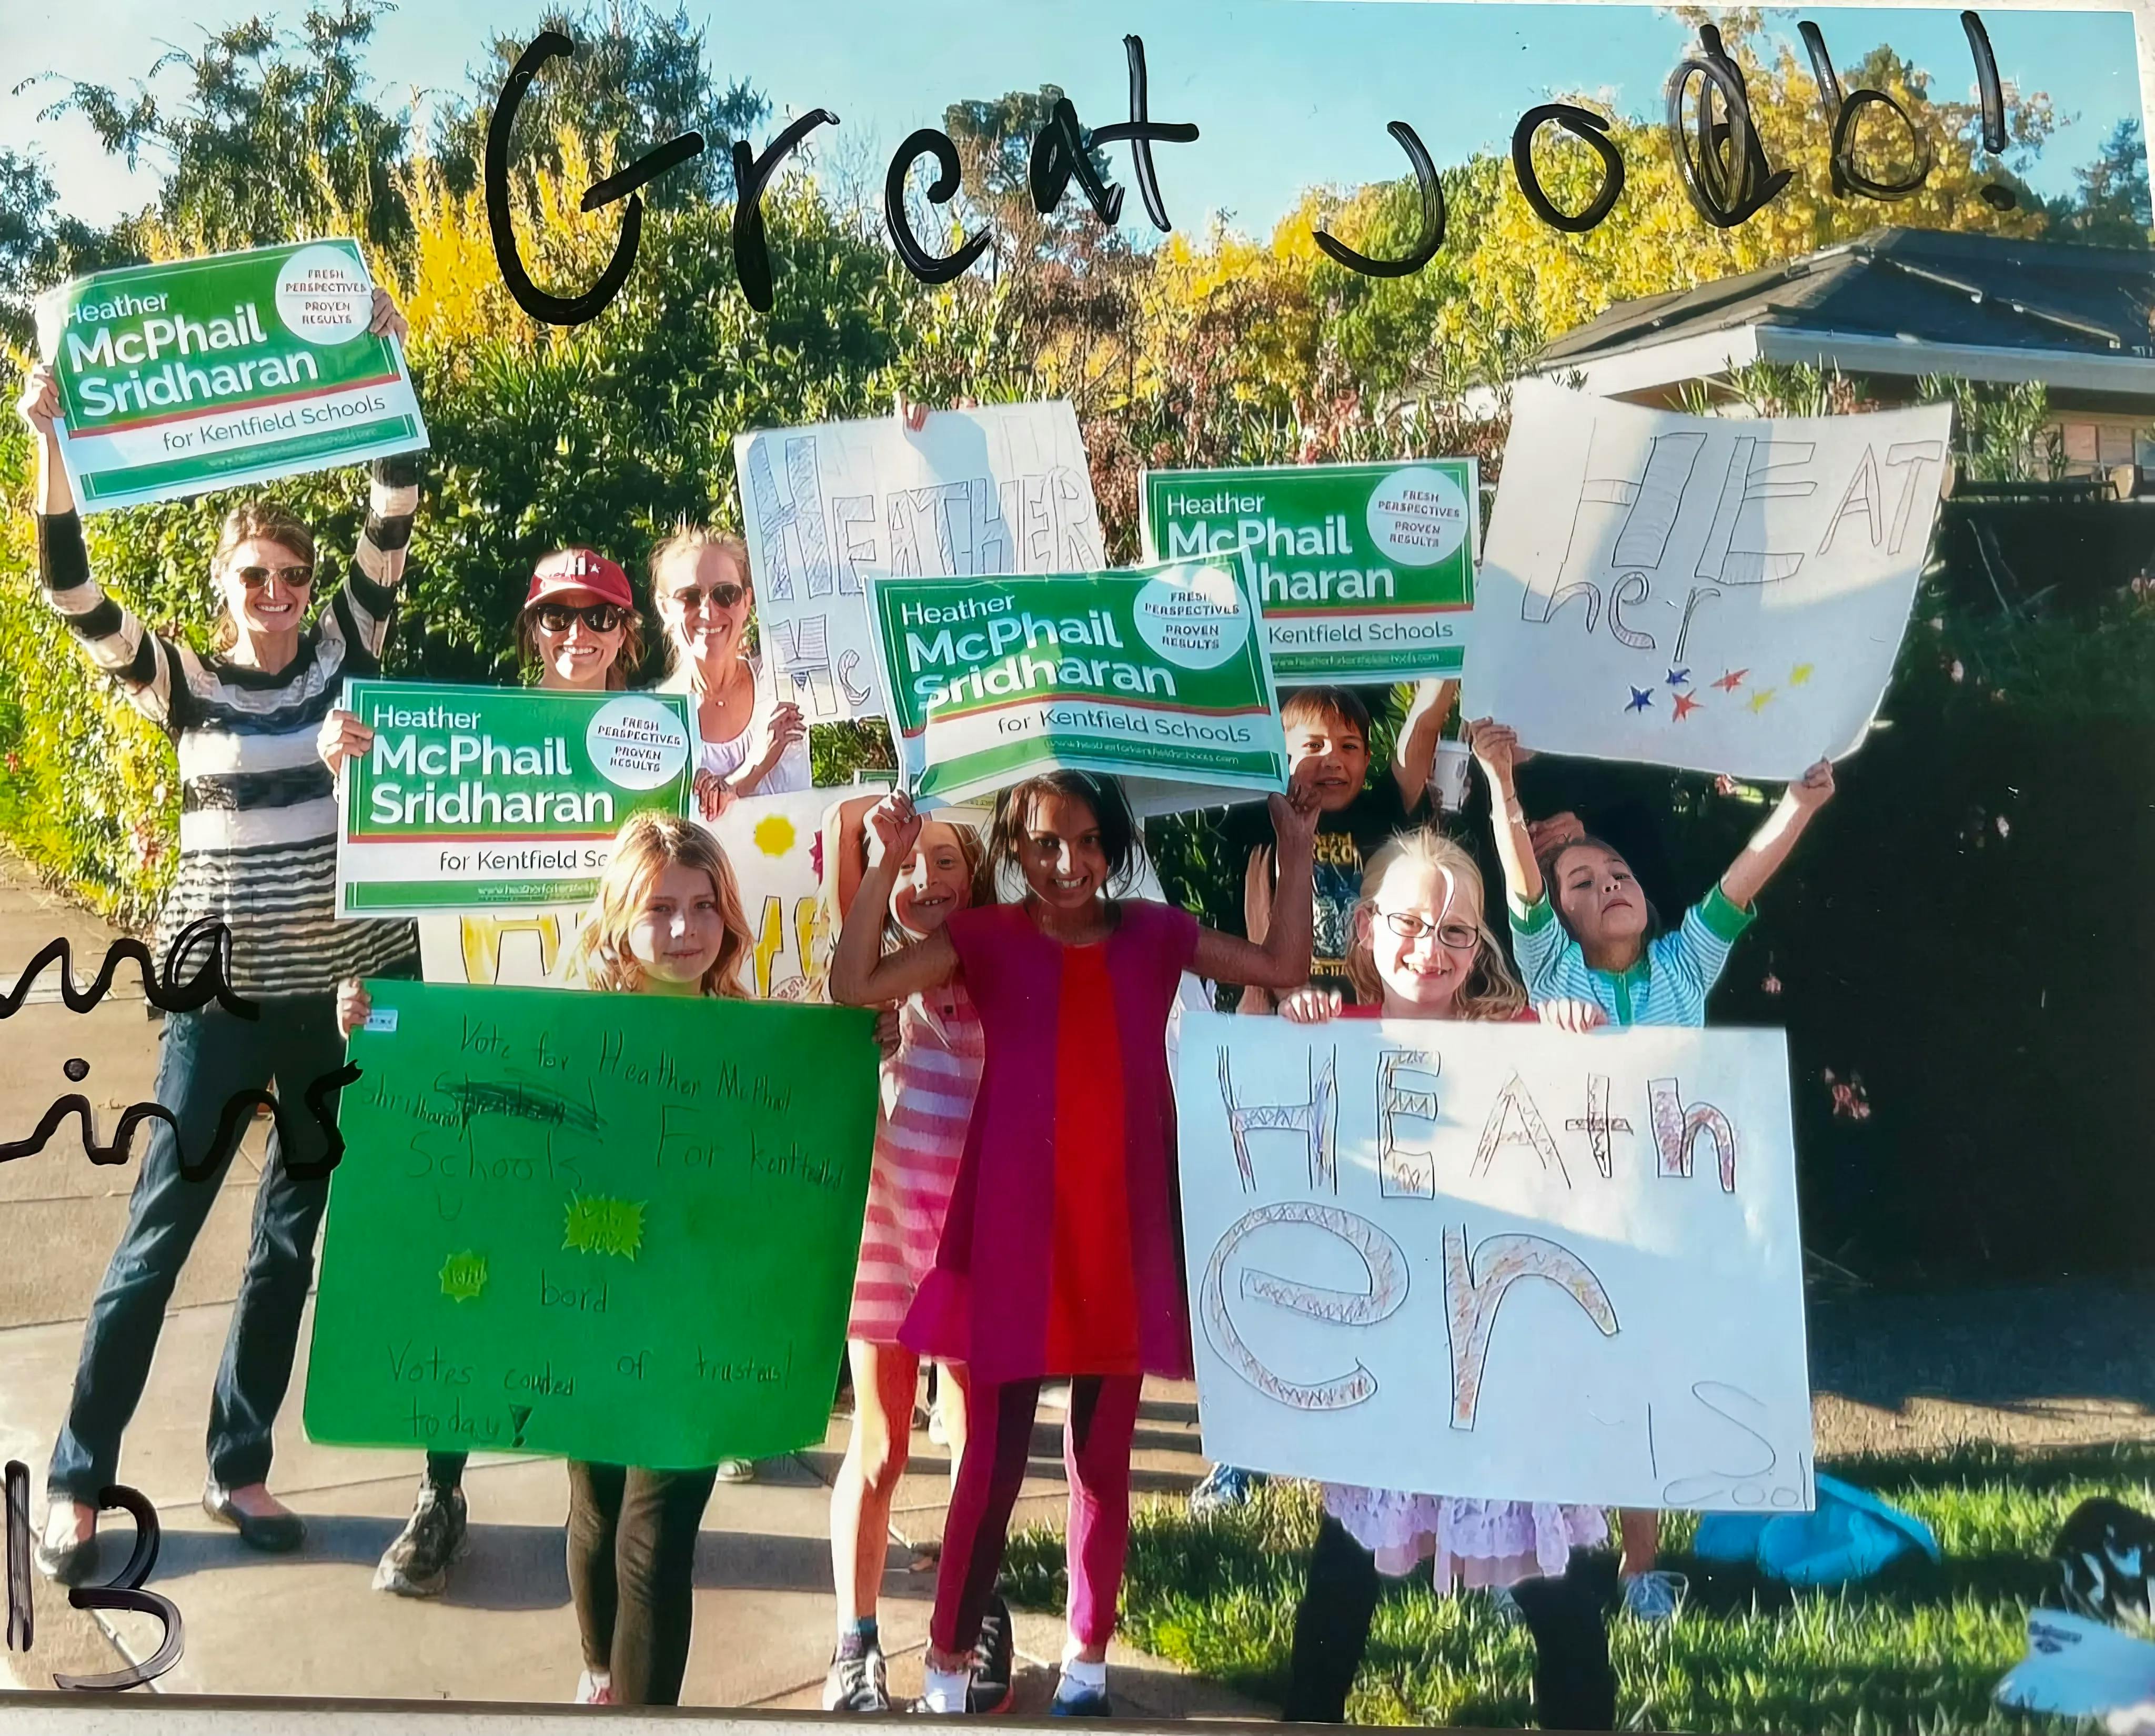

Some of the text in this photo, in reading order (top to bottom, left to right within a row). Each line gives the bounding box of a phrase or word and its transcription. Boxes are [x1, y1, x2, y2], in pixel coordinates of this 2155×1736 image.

[485, 31, 1200, 326] Great
[64, 291, 169, 326] Heather
[66, 302, 268, 374] McPhail
[79, 348, 319, 418] Sridharan
[164, 431, 194, 452] for
[200, 410, 297, 446] Kentfield
[303, 395, 386, 426] Schools
[1166, 493, 1265, 517] Heather
[1167, 514, 1353, 563] McPhail
[1263, 562, 1395, 602] haran
[901, 594, 1016, 627] Heather
[1268, 620, 1454, 644] Kentfield Schools
[905, 609, 1124, 673] McPhail
[913, 654, 1177, 711] Sridharan
[373, 704, 482, 729] Heather
[998, 708, 1251, 743] for Kentfield Schools
[371, 734, 573, 776] McPhail
[369, 781, 615, 824] Sridharan
[440, 851, 471, 871] for
[478, 850, 577, 871] Kentfield
[461, 1012, 510, 1059] Vote
[531, 1030, 569, 1071] for
[1199, 1200, 1622, 1431] er
[387, 1339, 476, 1386] Votes
